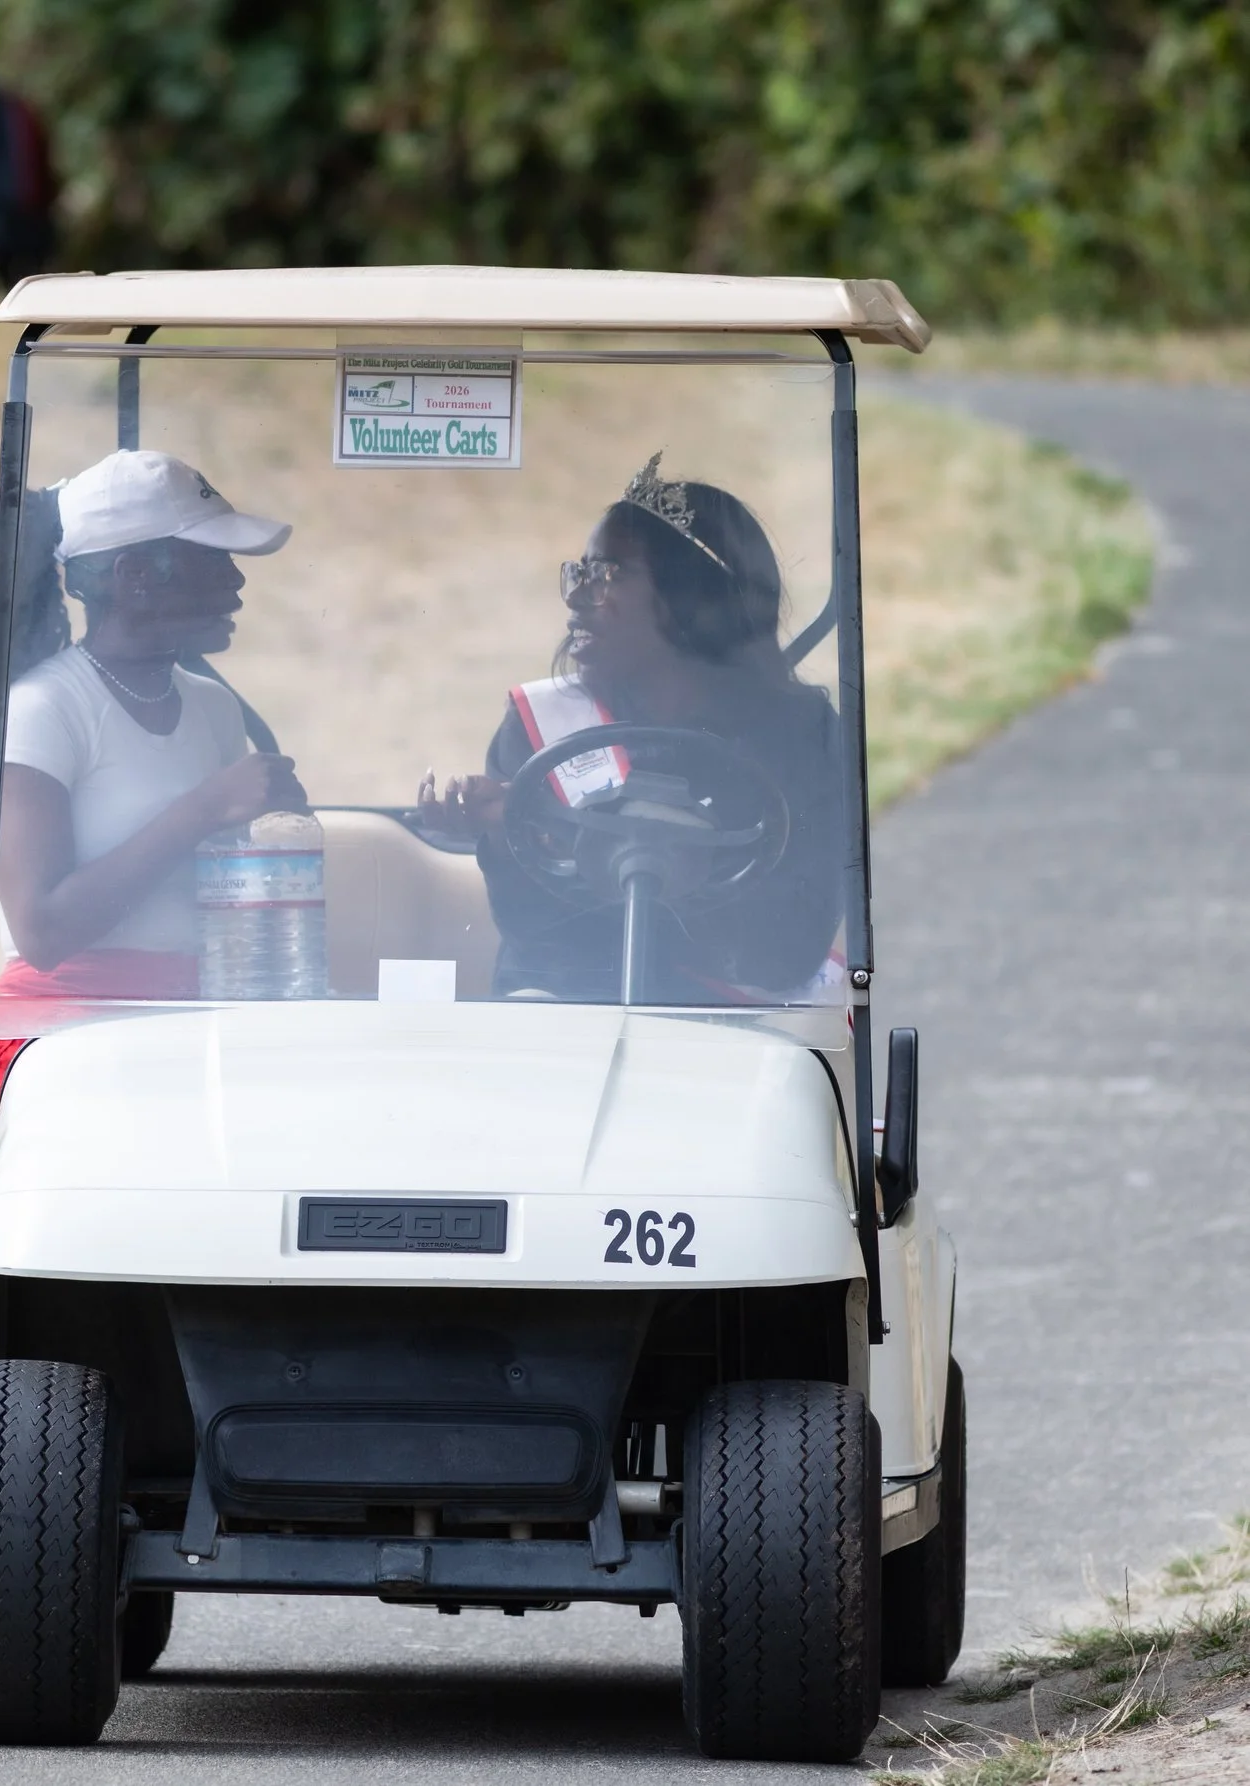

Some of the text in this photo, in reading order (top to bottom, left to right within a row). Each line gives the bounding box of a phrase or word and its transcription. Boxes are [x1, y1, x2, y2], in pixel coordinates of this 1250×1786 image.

[382, 358, 409, 371] Project
[411, 359, 445, 372] Celebrity
[448, 359, 465, 370] Golf
[465, 360, 511, 371] Tournament
[348, 389, 380, 398] MITZ
[444, 385, 470, 396] 2026
[424, 398, 493, 410] Tournament
[350, 417, 498, 456] Volunteer Carts
[603, 1208, 697, 1269] 262
